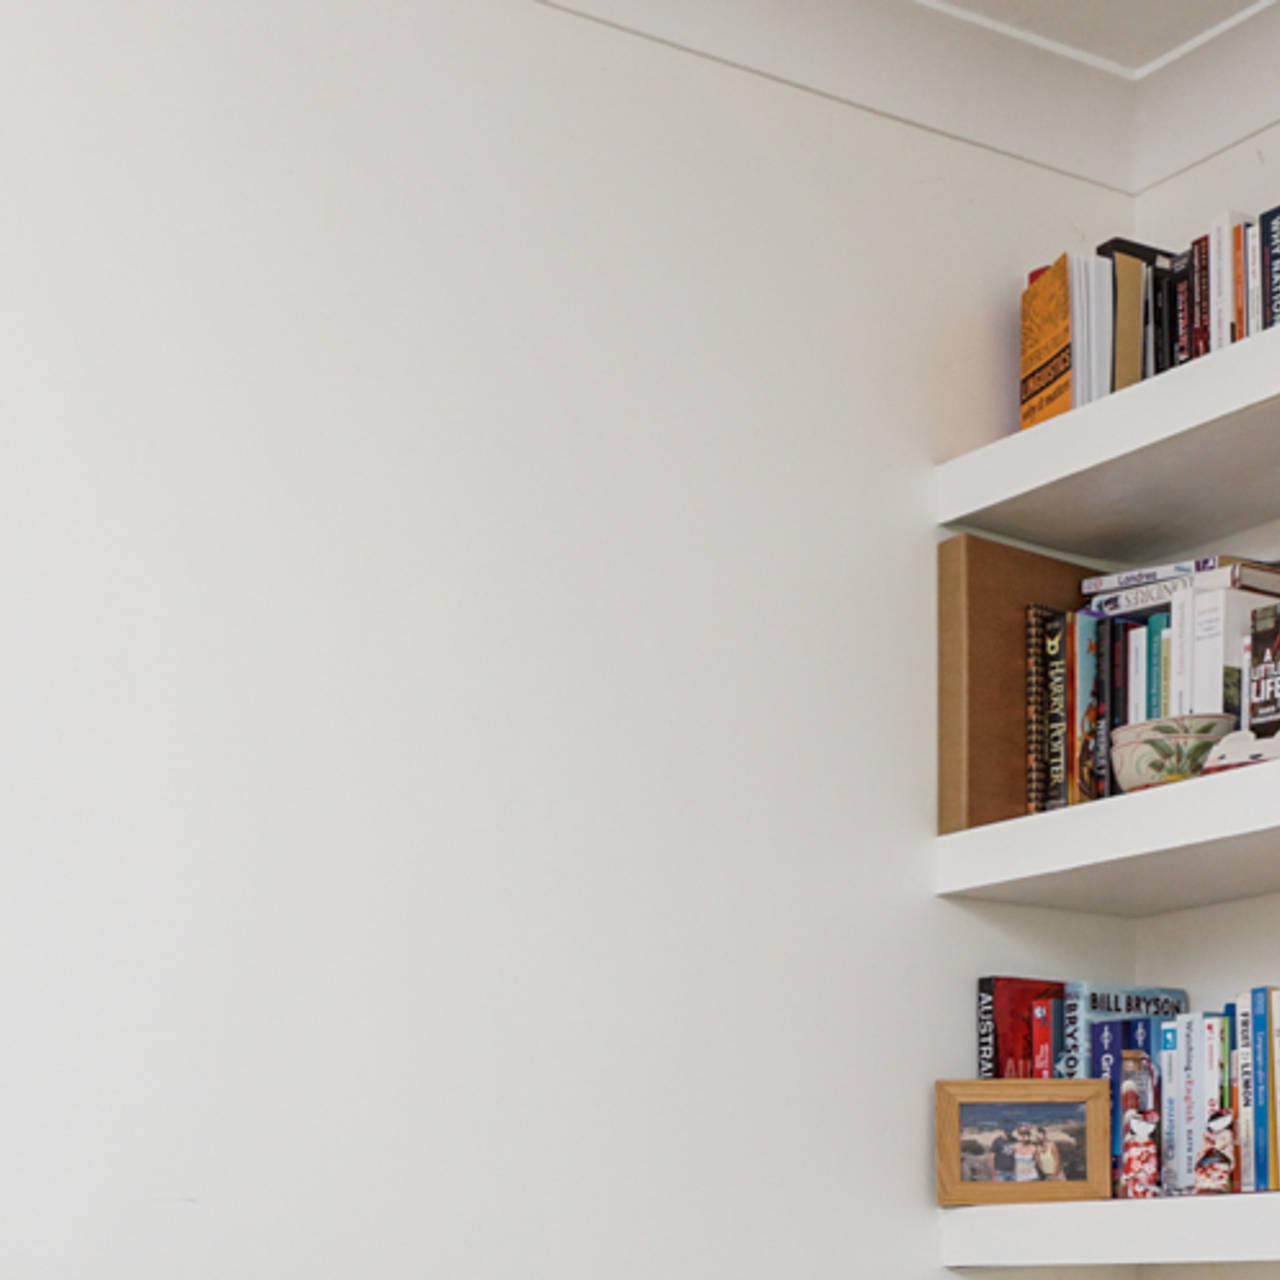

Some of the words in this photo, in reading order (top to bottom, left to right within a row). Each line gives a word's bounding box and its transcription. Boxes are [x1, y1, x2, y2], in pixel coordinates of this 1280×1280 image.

[1047, 660, 1065, 716] HARRY
[1049, 720, 1065, 786] POTTER
[1090, 993, 1122, 1013] BILL
[1125, 994, 1182, 1018] BRYSON
[1184, 1079, 1195, 1124] English
[1241, 1063, 1253, 1108] LEMON
